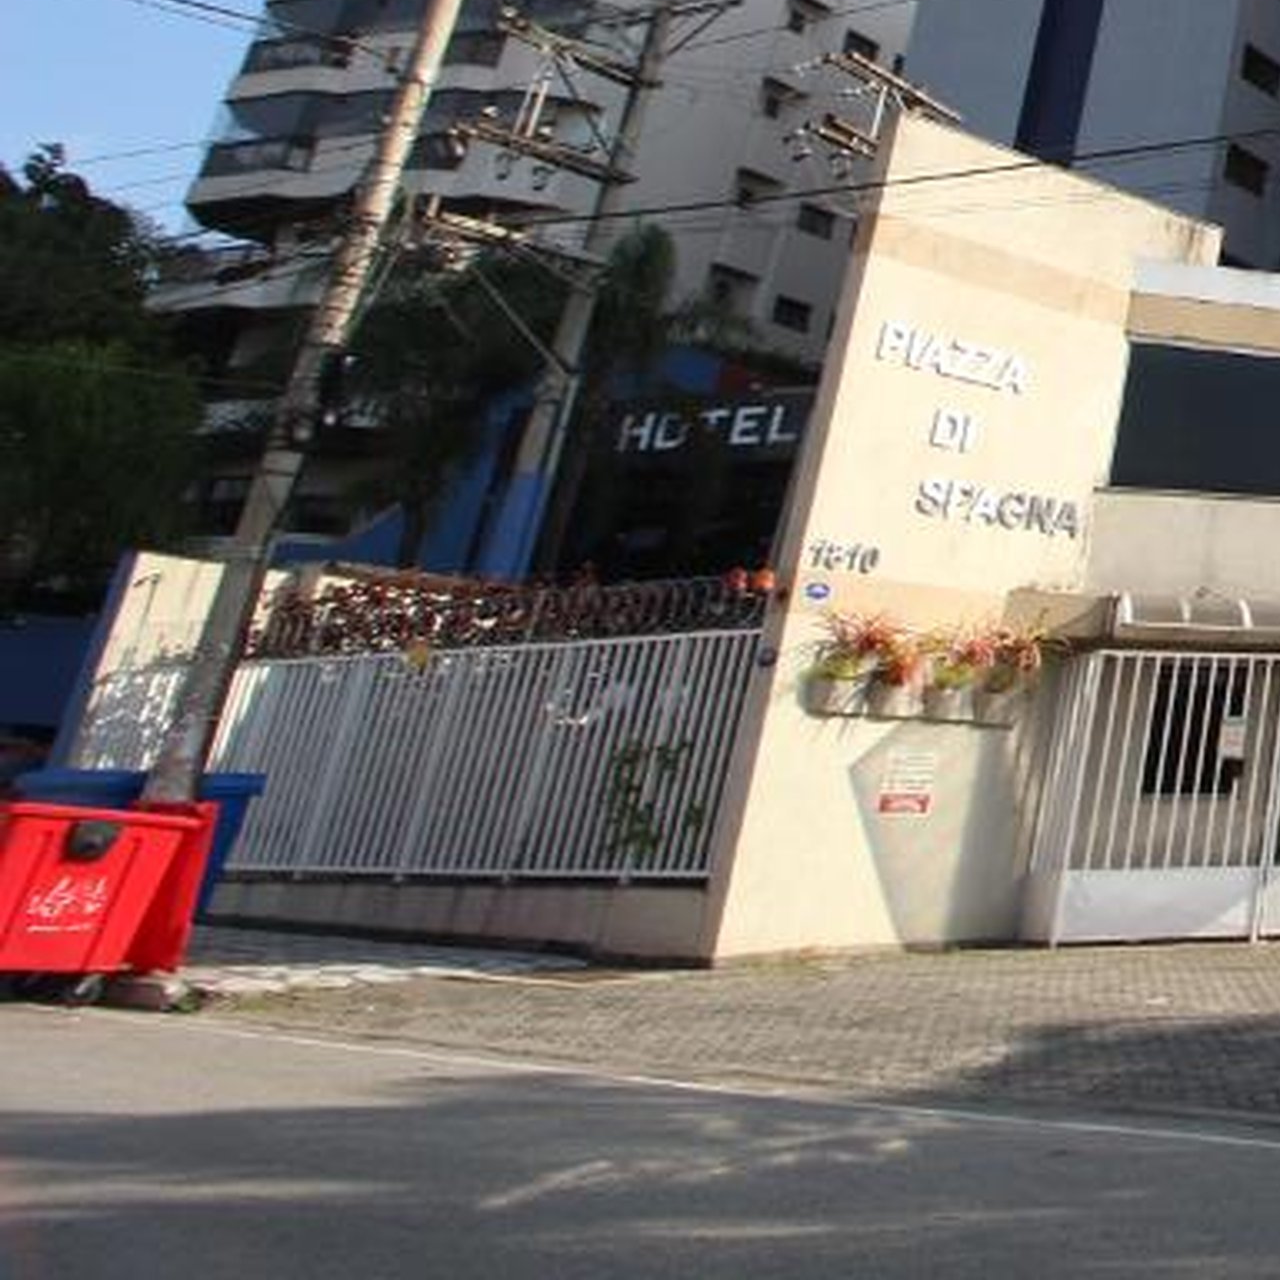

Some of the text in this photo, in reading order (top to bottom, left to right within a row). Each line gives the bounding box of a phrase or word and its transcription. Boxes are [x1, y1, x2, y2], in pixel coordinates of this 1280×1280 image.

[876, 320, 1028, 394] PIAZZA
[928, 406, 975, 453] DI
[915, 479, 1078, 539] SPAGNA
